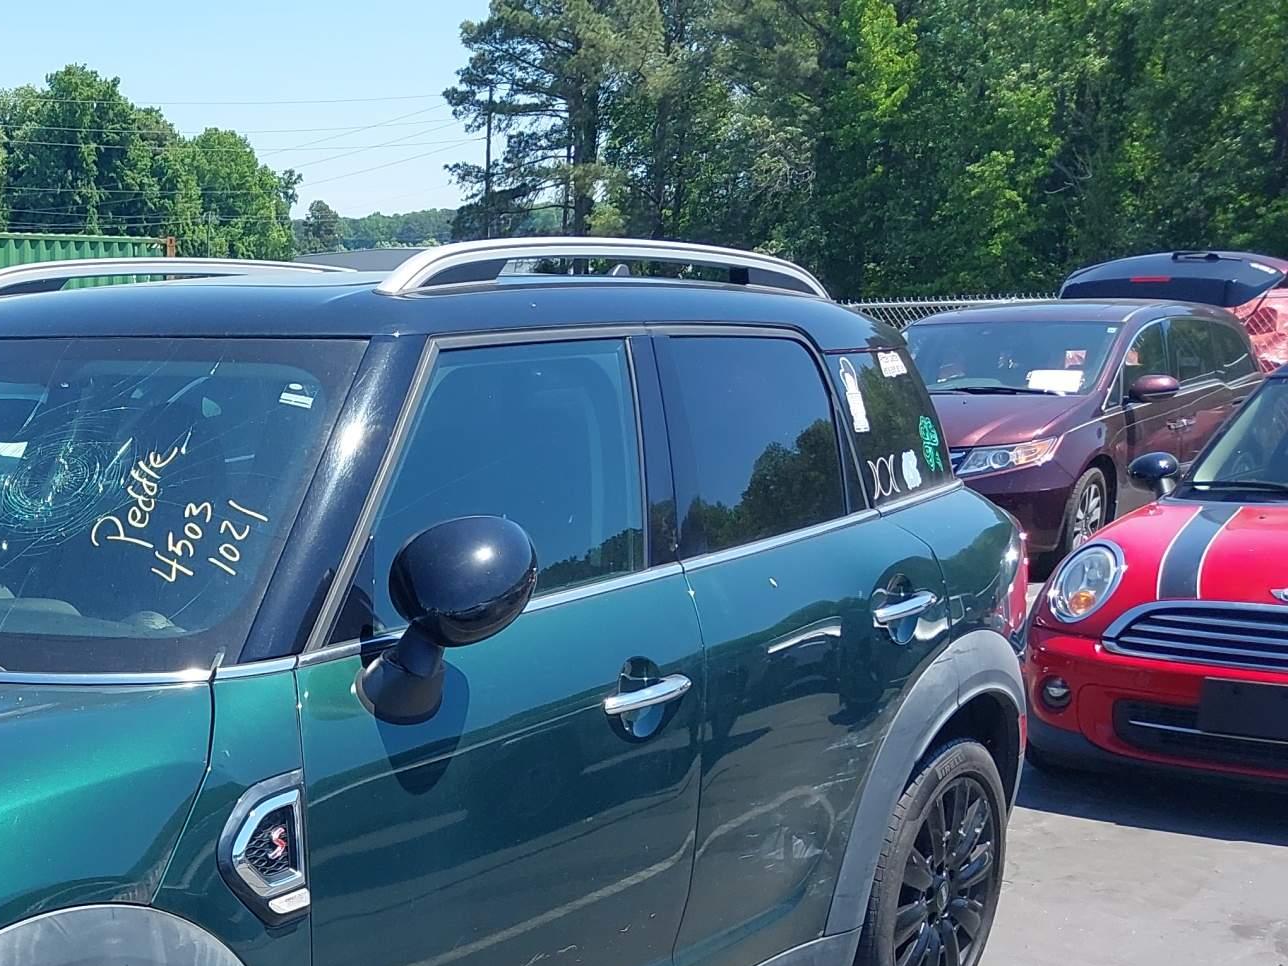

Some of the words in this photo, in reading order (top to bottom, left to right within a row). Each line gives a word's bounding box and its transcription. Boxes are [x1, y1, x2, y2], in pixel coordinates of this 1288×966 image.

[151, 501, 212, 583] 4503
[209, 499, 269, 576] 1021
[267, 826, 287, 860] S
